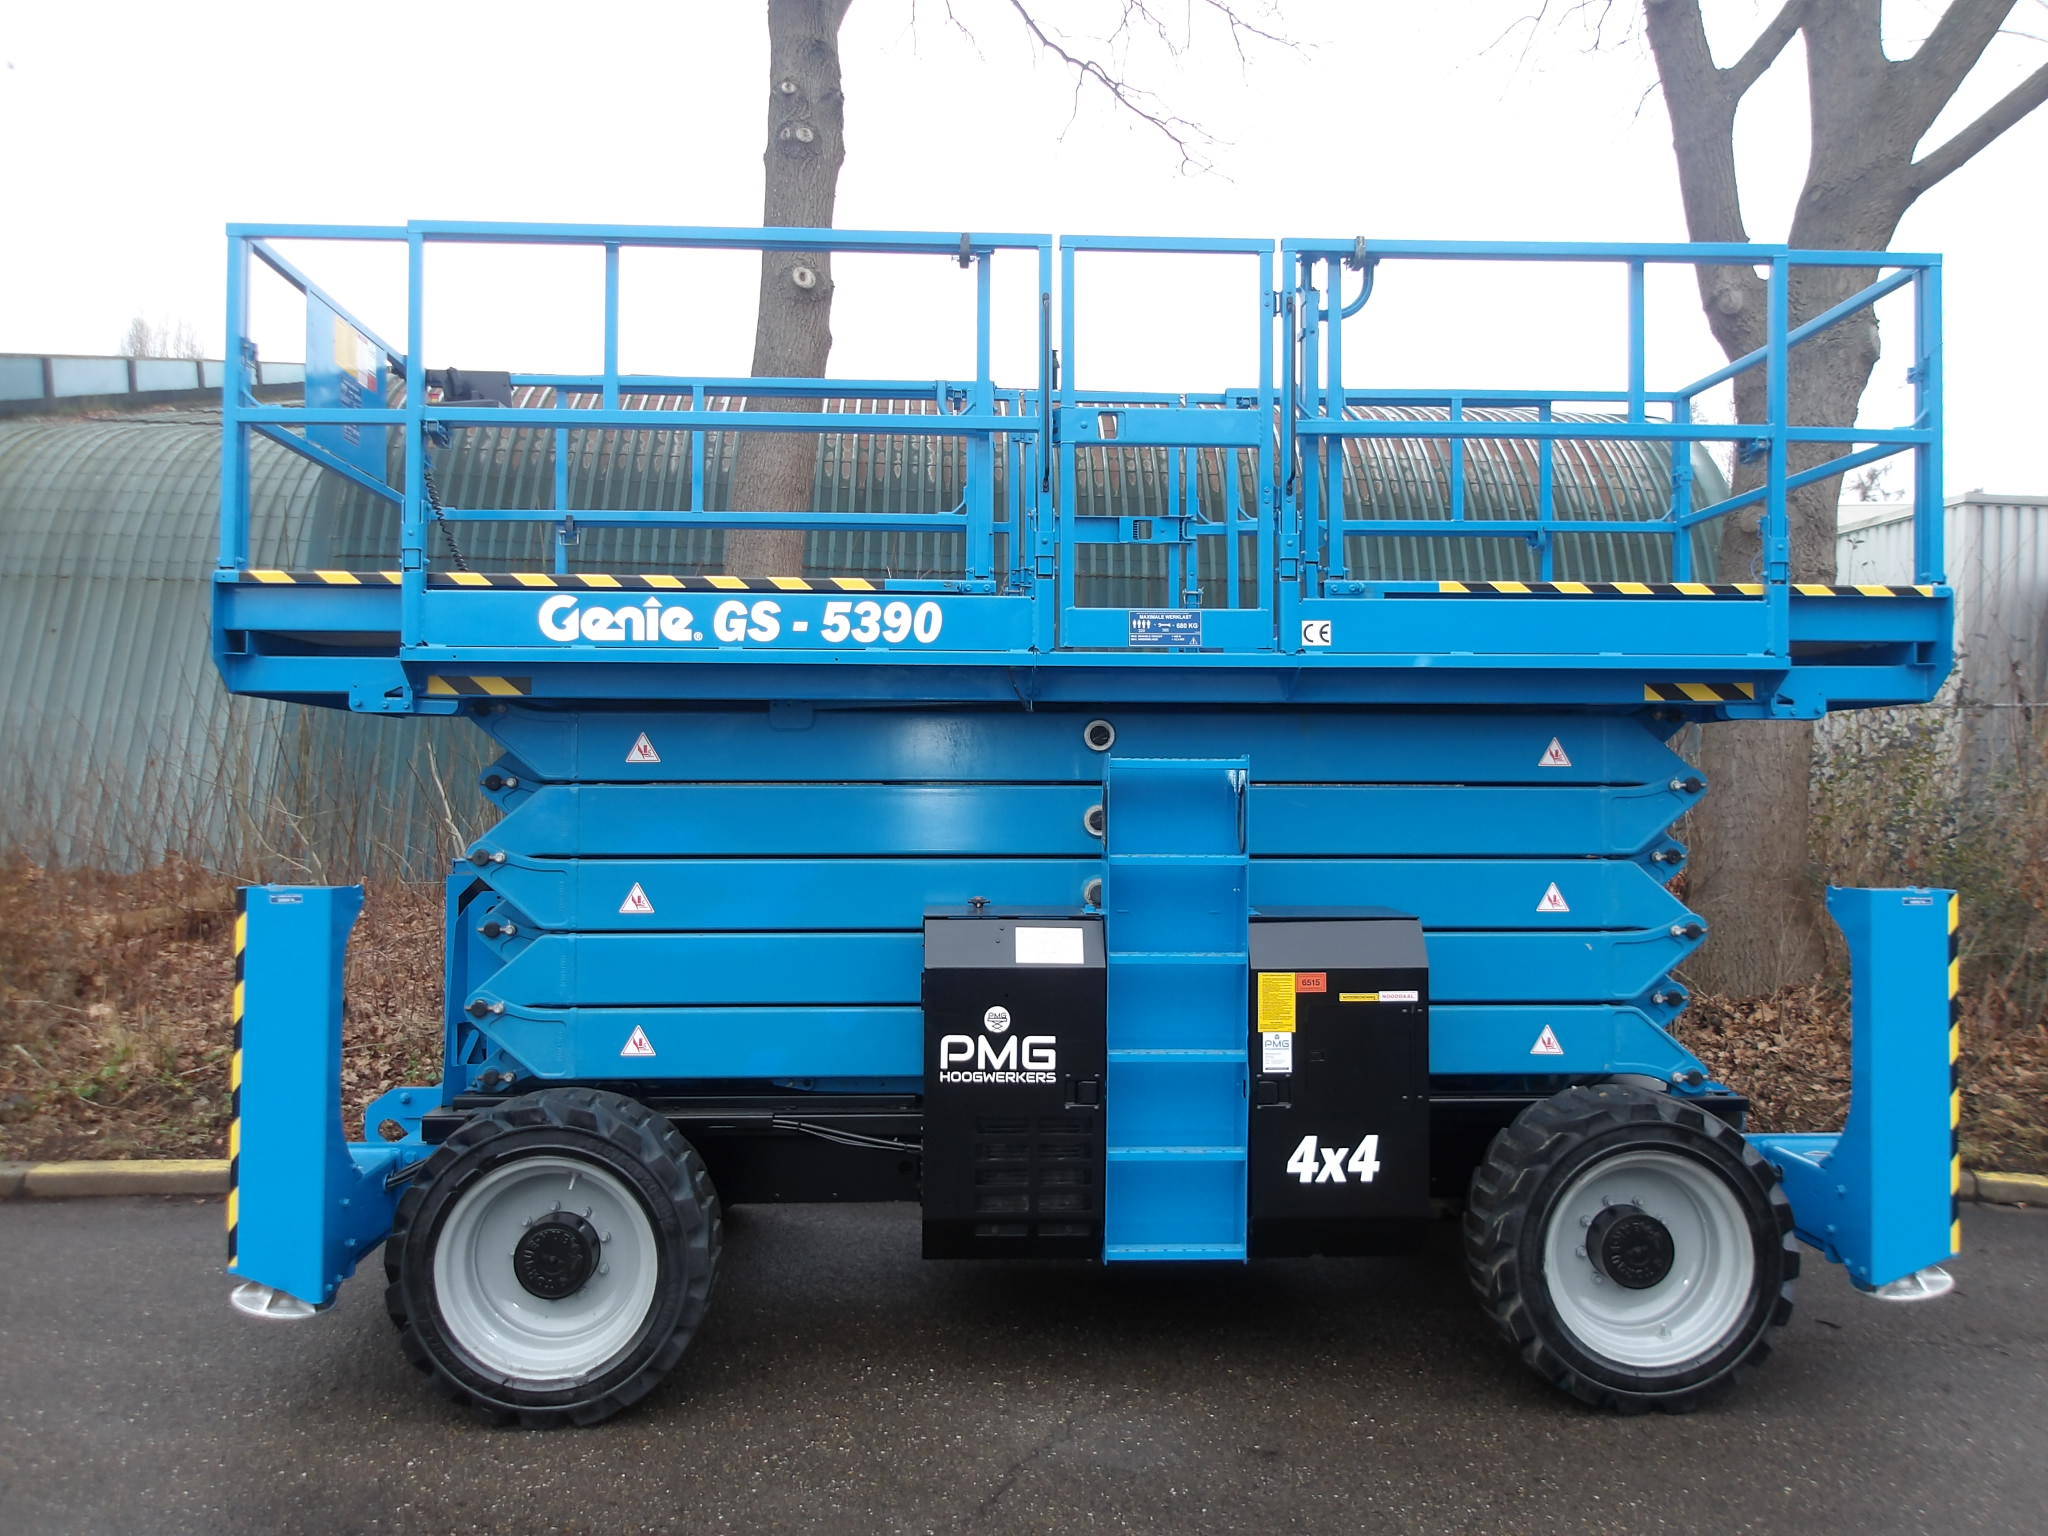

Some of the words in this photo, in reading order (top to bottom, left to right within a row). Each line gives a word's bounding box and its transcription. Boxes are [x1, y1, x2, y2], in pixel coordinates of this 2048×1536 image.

[538, 595, 694, 642] Genie
[713, 600, 781, 642] GS
[820, 601, 943, 643] 5390
[940, 1034, 1056, 1070] PMG
[1264, 1039, 1290, 1048] PMG
[939, 1071, 1057, 1083] HOOGWERKERS
[1286, 1134, 1381, 1184] 4x4
